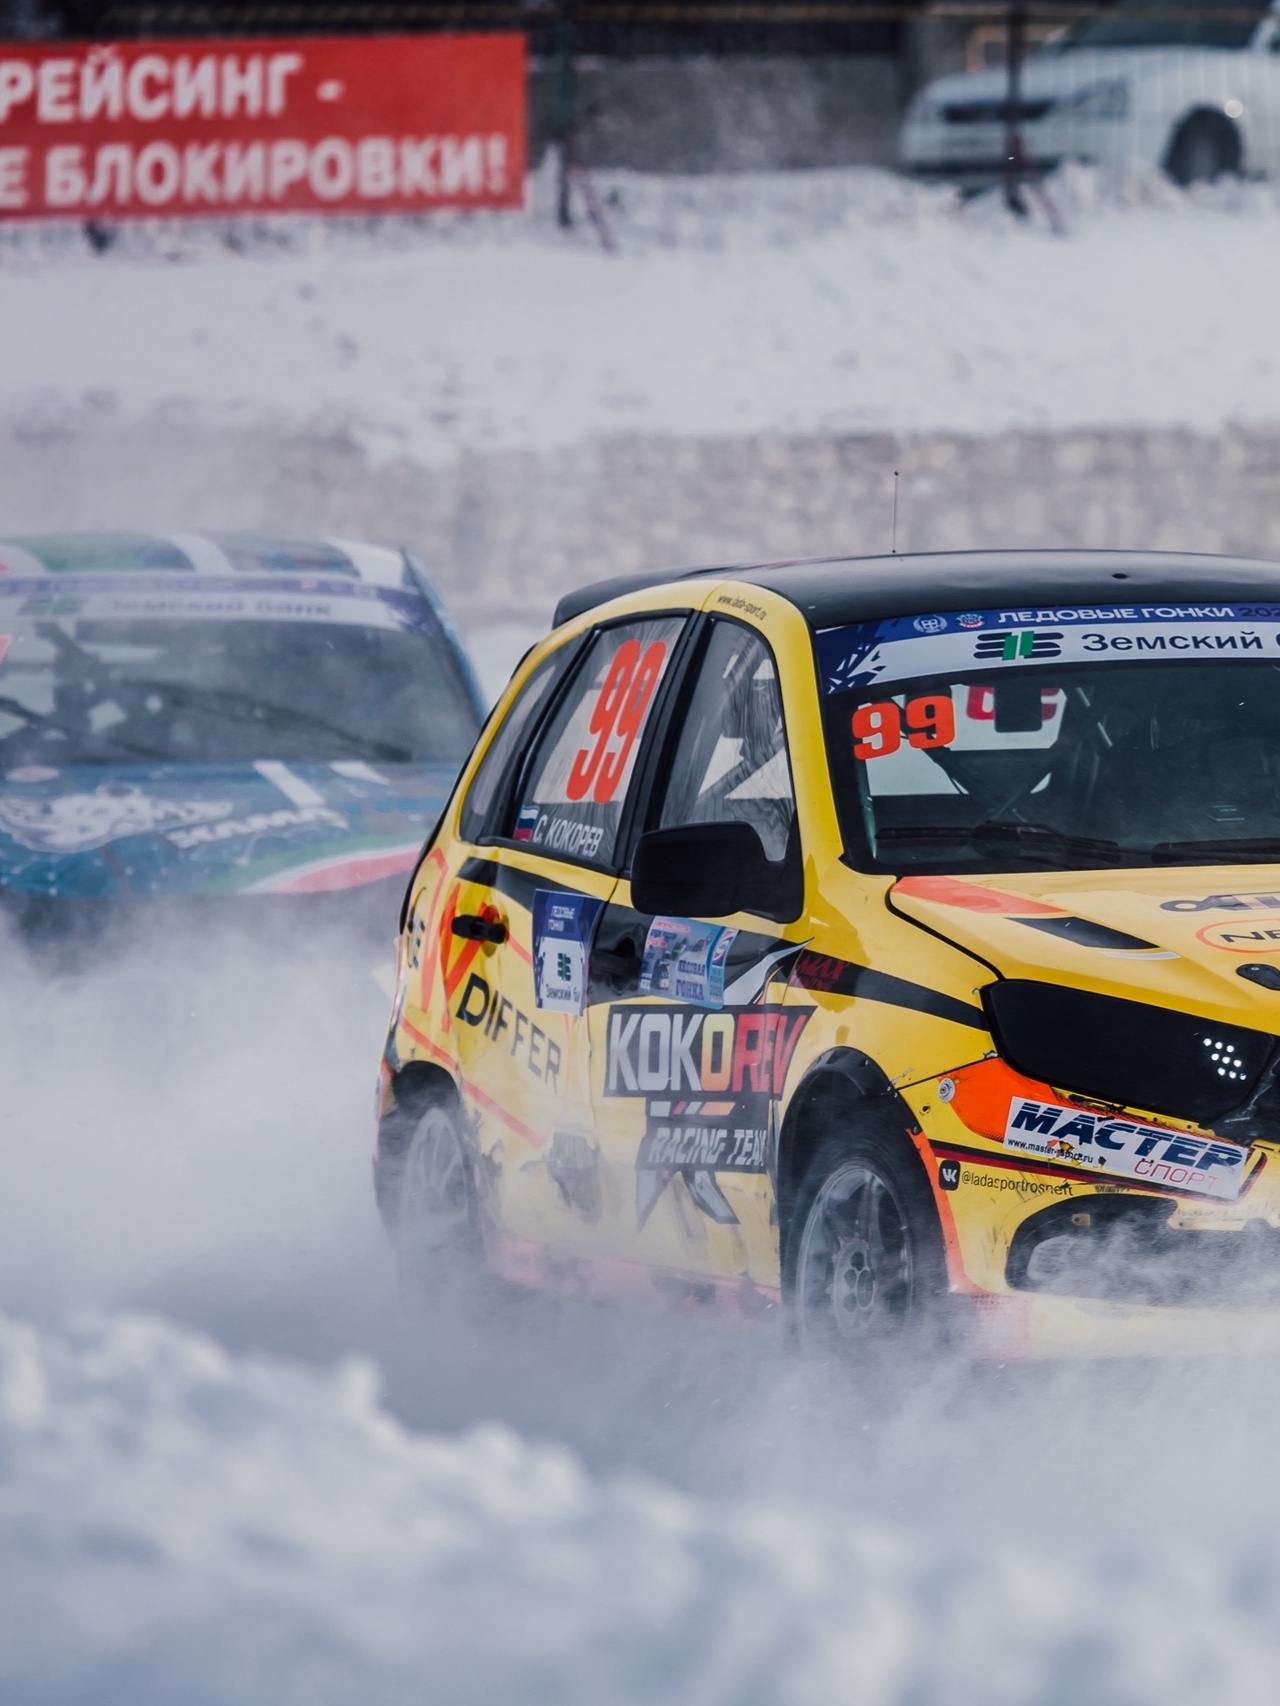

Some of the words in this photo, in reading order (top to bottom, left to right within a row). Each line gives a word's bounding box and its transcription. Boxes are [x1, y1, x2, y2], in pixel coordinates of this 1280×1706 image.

[0, 46, 302, 123] РЕЙСИНГ
[44, 132, 508, 207] БЛОКИРОВКИ!
[998, 609, 1138, 624] ЛЕДОВЫЕ
[1140, 607, 1235, 619] ГОНКИ
[1080, 631, 1264, 652] Земский
[565, 639, 667, 804] 99
[851, 695, 956, 761] 99
[547, 815, 604, 858] КОКОРЕВ
[608, 1013, 808, 1094] KOKOREV
[647, 1127, 728, 1164] RACING
[1011, 1101, 1243, 1171] МАСТЕР
[1133, 1161, 1223, 1191] СПОРТ
